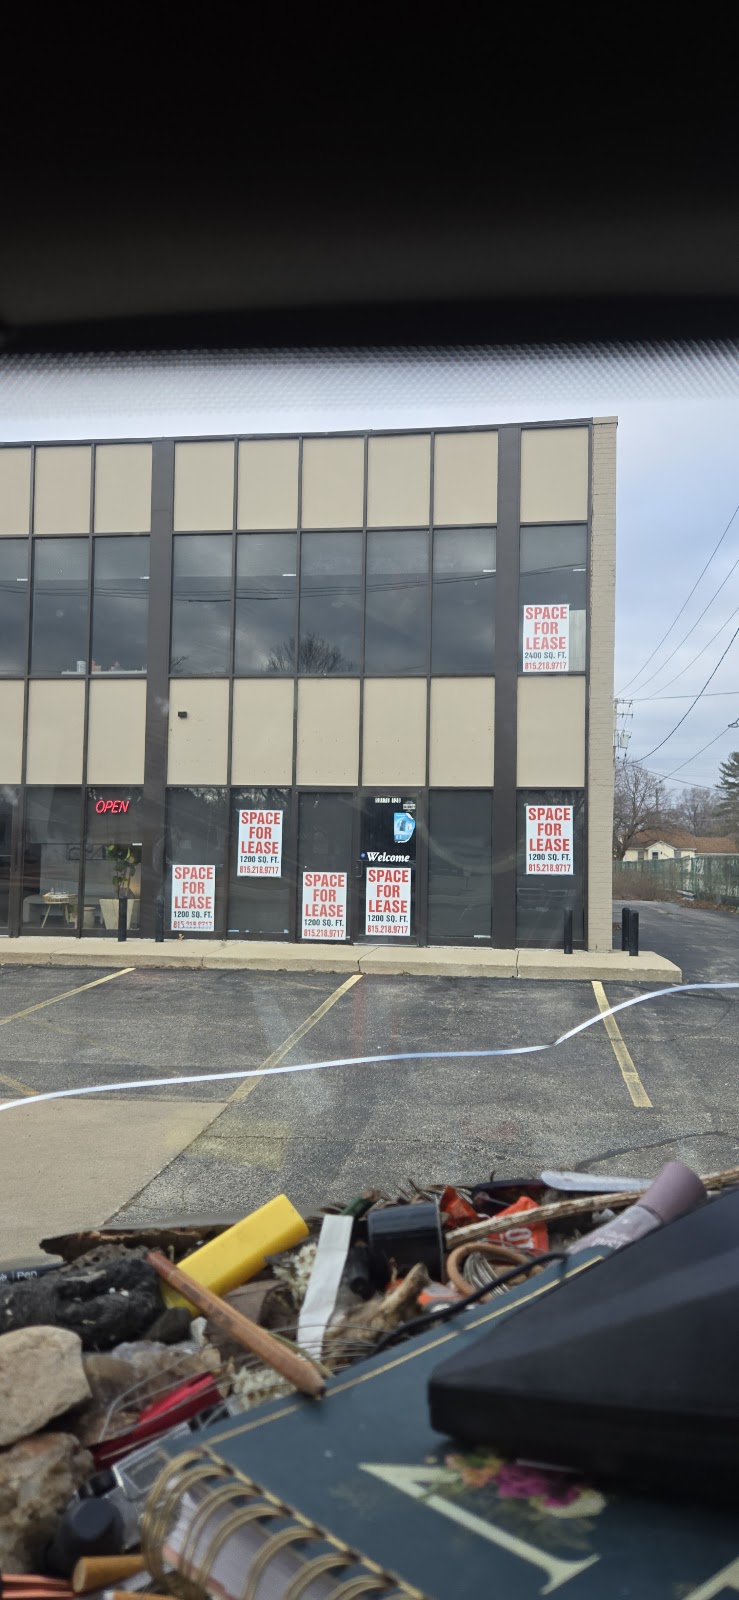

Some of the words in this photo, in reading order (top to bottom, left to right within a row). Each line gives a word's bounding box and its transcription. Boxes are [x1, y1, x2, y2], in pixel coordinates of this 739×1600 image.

[525, 606, 567, 620] SPACE
[534, 621, 559, 635] FOR
[525, 636, 566, 650] LEASE
[524, 651, 542, 659] 2400
[524, 662, 567, 670] 815.218.9717
[95, 799, 130, 814] OPEN
[241, 812, 280, 825] SPACE
[528, 807, 571, 821] SPACE
[249, 827, 272, 839] FOR
[537, 823, 562, 836] FOR
[241, 841, 279, 854] LEASE
[529, 838, 570, 852] LEASE
[257, 856, 268, 864] SQ.
[366, 851, 410, 862] Welcome
[174, 867, 213, 880] SPACE
[239, 865, 279, 874] 815.218.9717
[528, 864, 571, 872] 815.218.9717
[305, 874, 345, 887] SPACE
[368, 869, 409, 883] SPACE
[182, 881, 205, 894] FOR
[376, 885, 400, 898] FOR
[313, 889, 336, 902] FOR
[174, 896, 212, 909] LEASE
[368, 900, 407, 913] LEASE
[305, 904, 343, 917] LEASE
[322, 919, 333, 927] SQ.
[367, 914, 384, 922] 1200
[386, 915, 397, 923] SQ.
[399, 915, 408, 923] FT.
[303, 929, 344, 937] 815.218.9717
[367, 925, 408, 934] 815.218.9717
